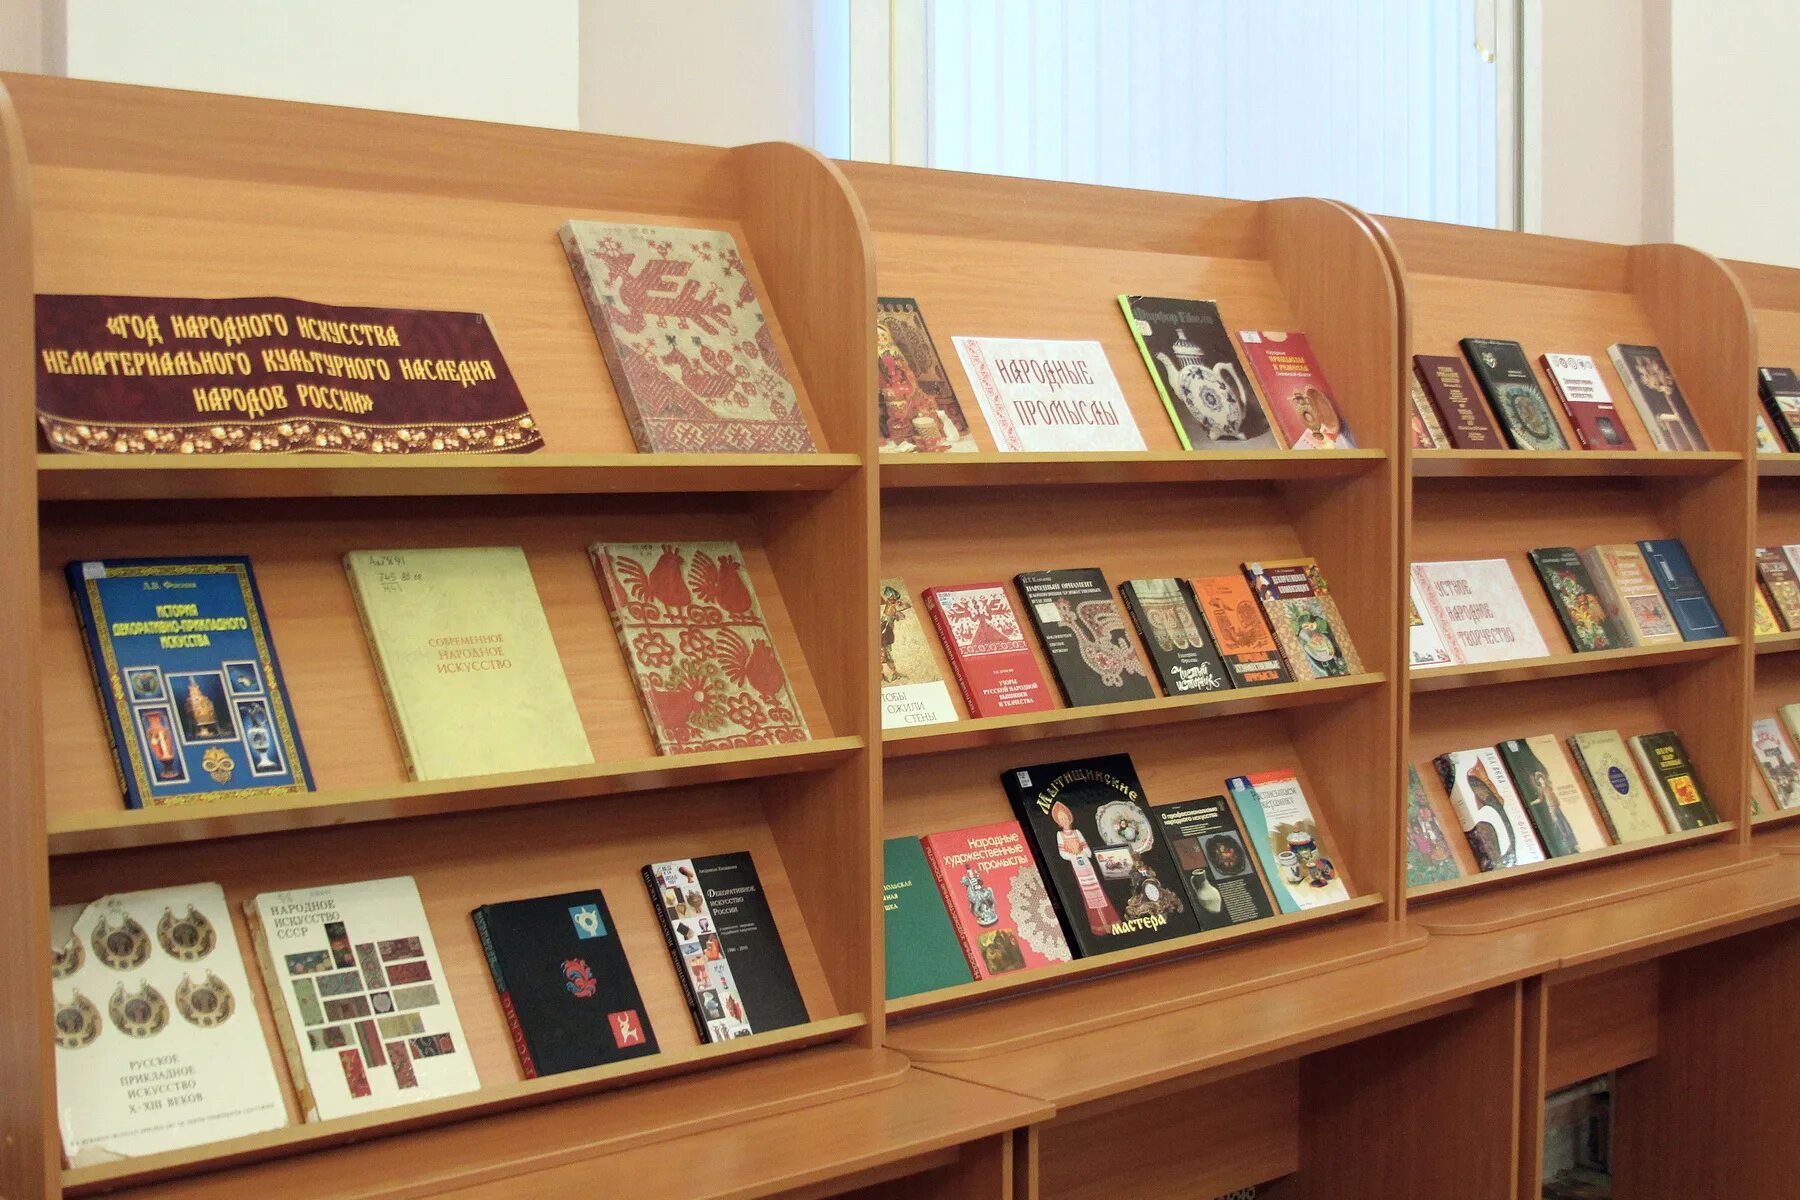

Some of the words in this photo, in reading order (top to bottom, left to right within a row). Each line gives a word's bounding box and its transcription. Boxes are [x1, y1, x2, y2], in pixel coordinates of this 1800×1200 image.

[106, 314, 163, 347] «ГОД
[170, 314, 289, 347] НАРОДНОГО
[296, 316, 401, 347] ИСКУССТВА
[42, 349, 251, 376] НЕМАТЕРИАЛЬНОГО
[262, 349, 391, 381] КУЛЬТУРНОГО
[399, 359, 496, 388] НАСЛЕДИЯ
[995, 359, 1094, 392] НАРОДНЫЕ
[192, 385, 289, 419] НАРОДОВ
[296, 384, 374, 414] РОССИИ»
[1013, 400, 1120, 426] ПРОМЫСЛЫ
[1434, 579, 1472, 597] УСТНОЕ
[1446, 603, 1494, 624] НАРОДНОЕ
[428, 634, 504, 648] СОВРЕМЕННОЕ
[1457, 627, 1514, 647] ТВОРЧЕСТВО
[439, 647, 504, 660] НАРОДНОЕ
[437, 659, 512, 673] ИСКУССТВО
[881, 692, 907, 702] ТОБЫ
[983, 686, 1009, 695] РУССКОЙ
[887, 702, 925, 714] ОЖИЛИ
[905, 712, 937, 724] СТЕНЫ
[1164, 817, 1192, 825] народного
[968, 832, 1019, 849] Народные
[943, 844, 1023, 867] художественные
[978, 855, 1028, 873] промыслы
[884, 880, 912, 891] ОЛЬСКАЯ
[271, 900, 335, 916] НАРОДНОЕ
[274, 912, 340, 928] ИСКУССТВО
[277, 927, 308, 939] СССР
[129, 1054, 179, 1071] РУССКОЕ
[120, 1065, 196, 1087] ПРИКЛАДНОЕ
[128, 1080, 196, 1099] ИСКУССТВО
[167, 1092, 203, 1107] ВЕКОВ
